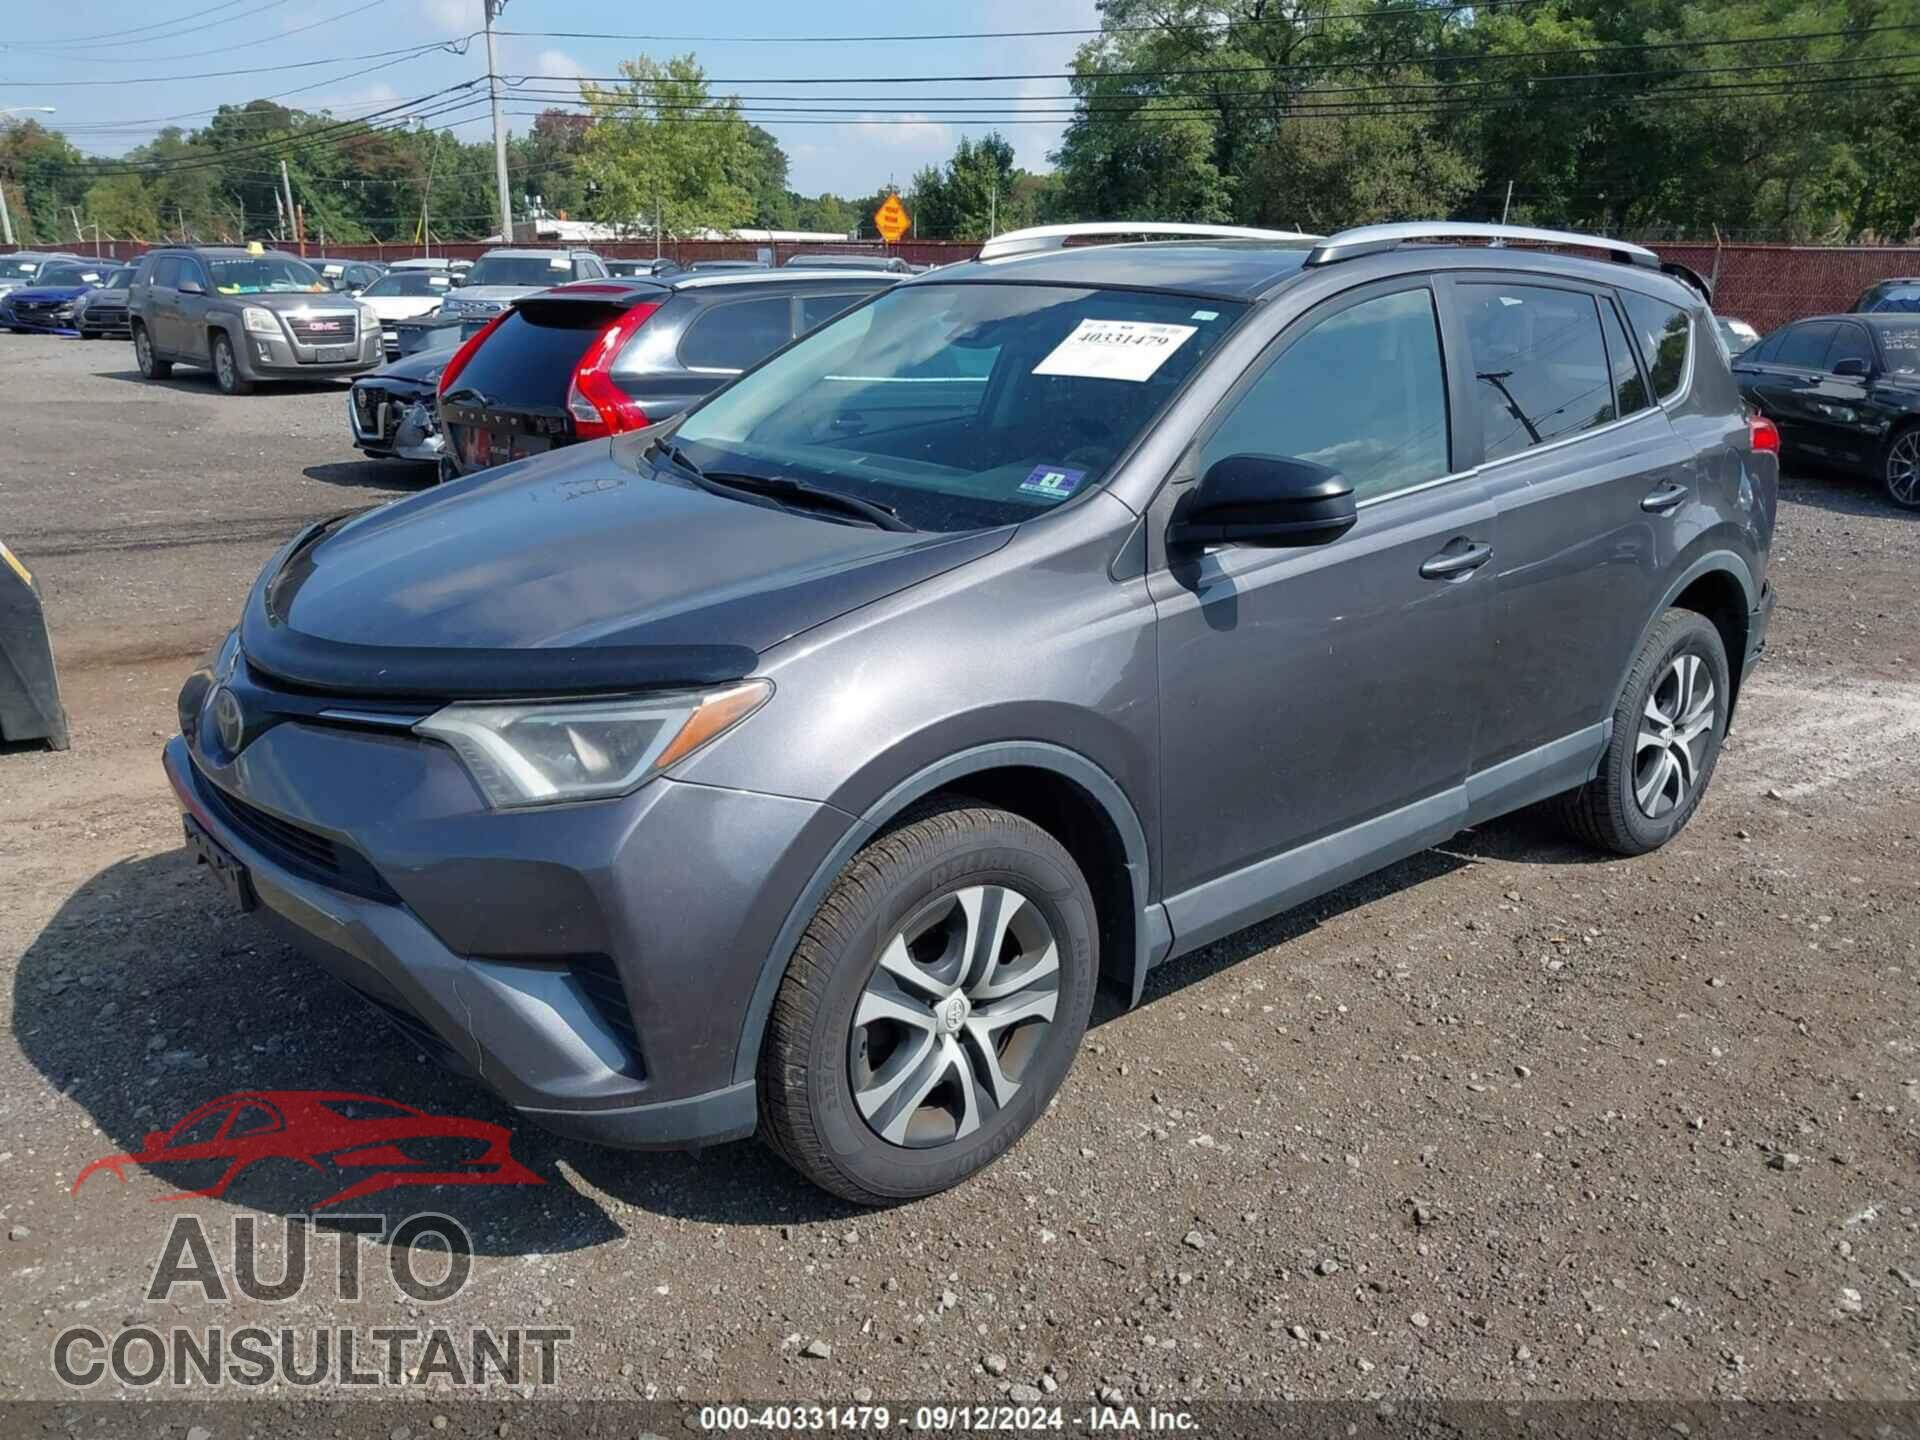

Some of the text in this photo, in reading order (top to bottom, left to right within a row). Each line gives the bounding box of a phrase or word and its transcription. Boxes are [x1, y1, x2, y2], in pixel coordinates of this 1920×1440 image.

[310, 322, 340, 331] GMC
[1078, 332, 1169, 346] 40331479
[457, 411, 519, 425] VOLVO
